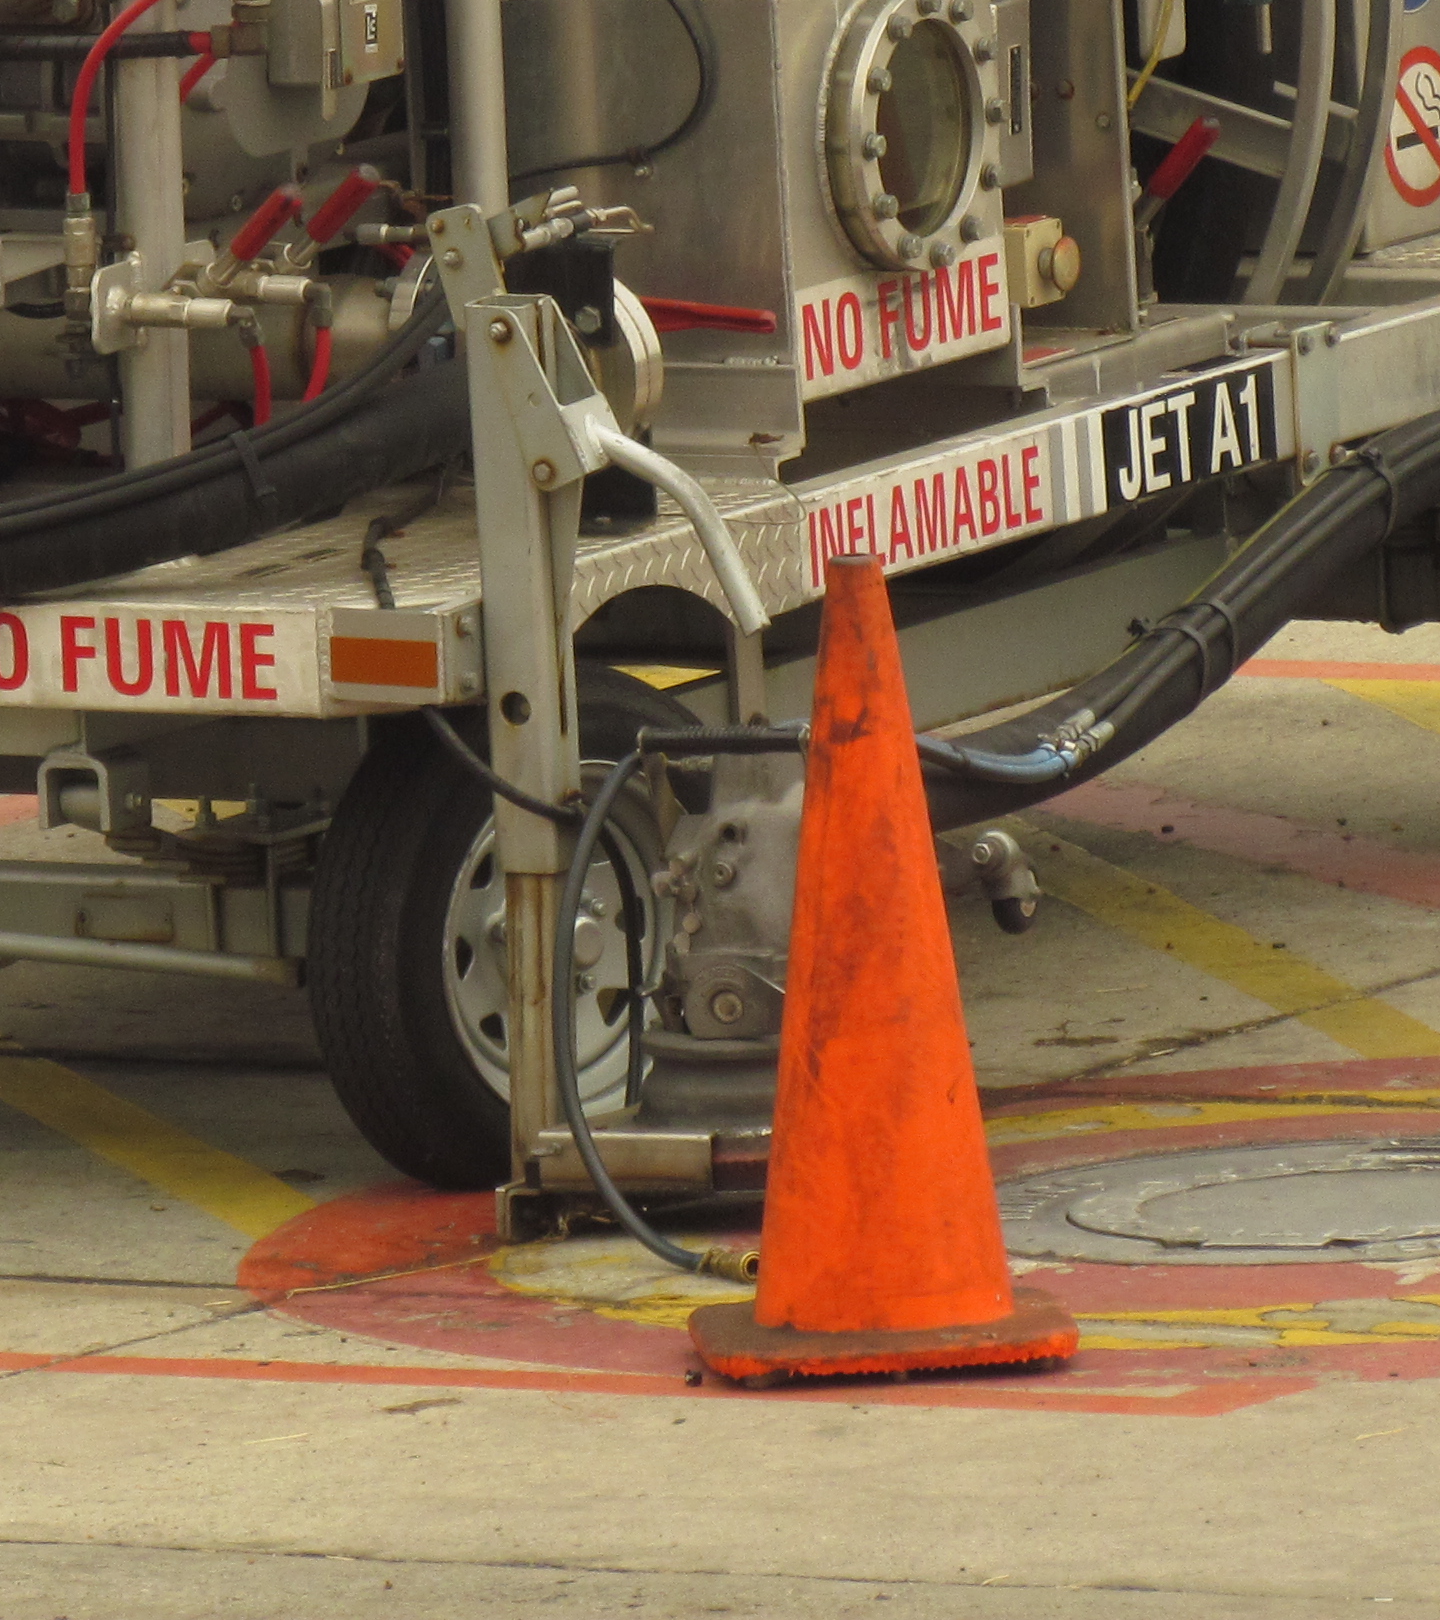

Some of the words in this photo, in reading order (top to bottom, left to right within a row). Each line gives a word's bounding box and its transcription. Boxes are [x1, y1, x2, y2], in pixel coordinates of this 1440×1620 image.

[802, 292, 863, 381] NO
[877, 253, 1002, 359] FUME
[1119, 391, 1196, 502] JET
[1210, 374, 1260, 475] A1
[809, 445, 1042, 588] INFLAMABLE
[61, 616, 278, 700] FUME
